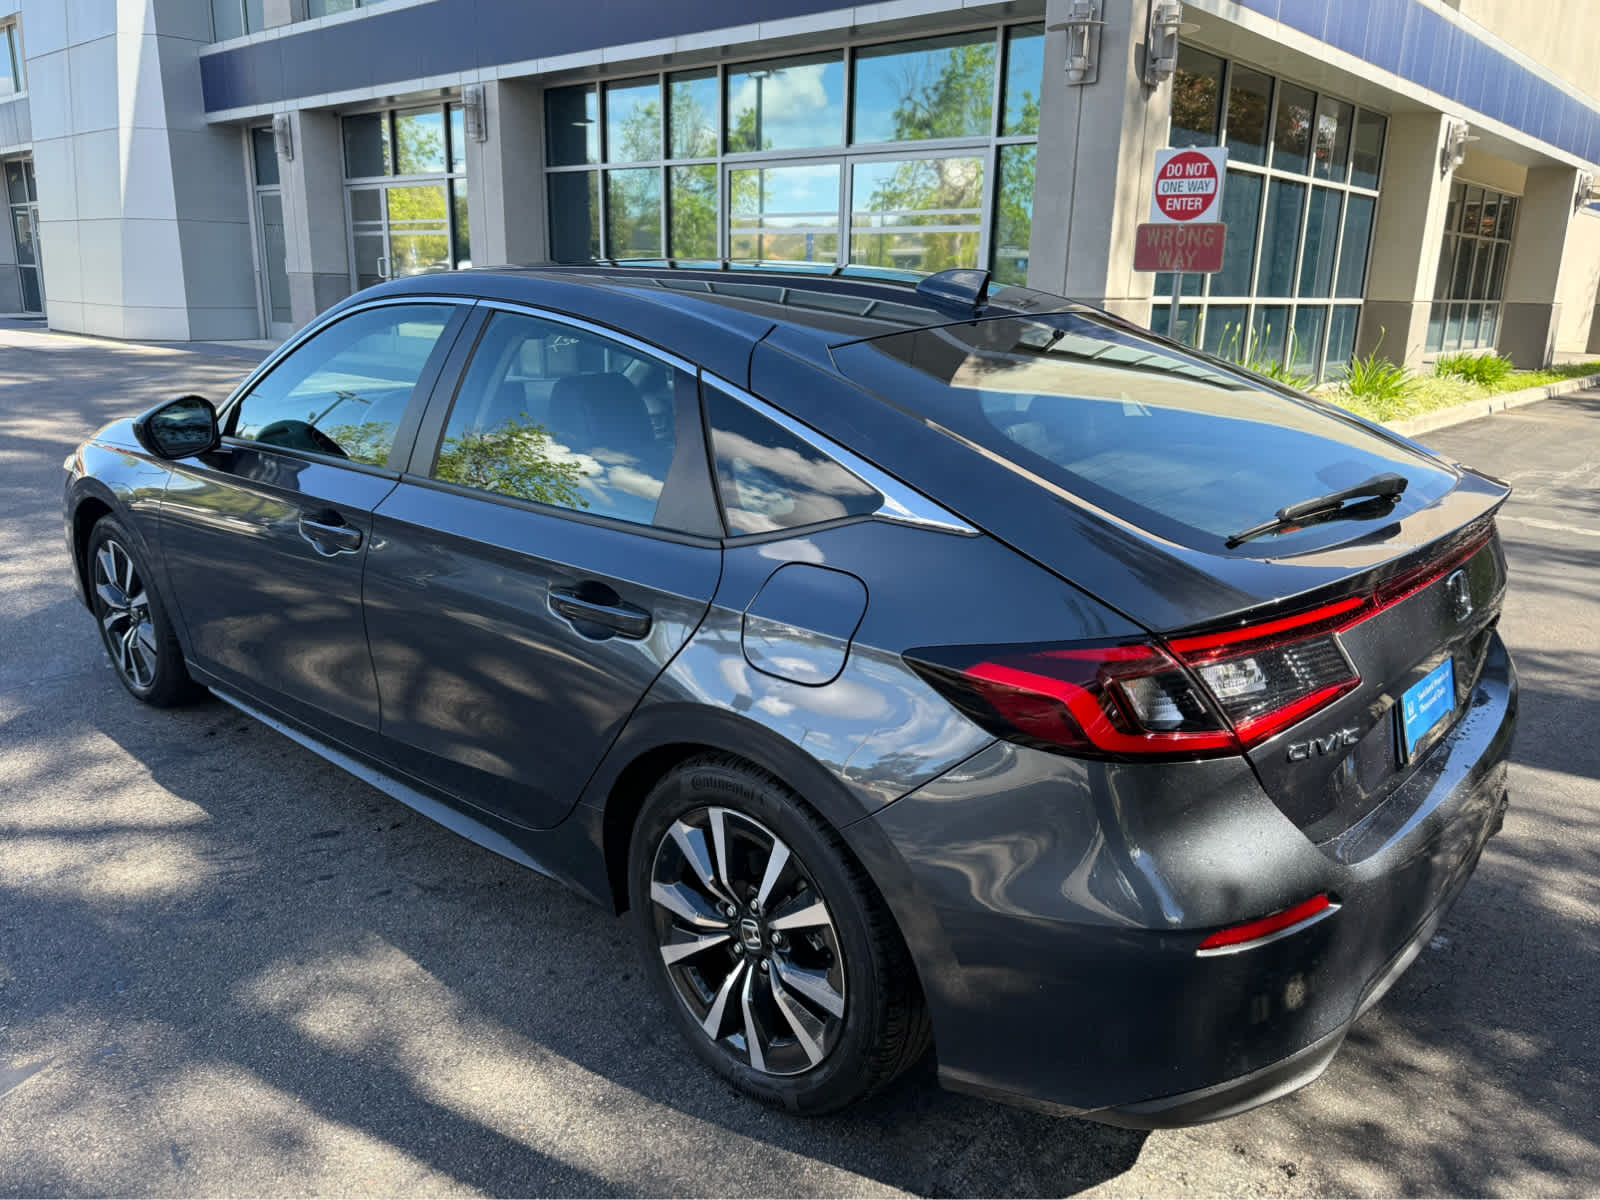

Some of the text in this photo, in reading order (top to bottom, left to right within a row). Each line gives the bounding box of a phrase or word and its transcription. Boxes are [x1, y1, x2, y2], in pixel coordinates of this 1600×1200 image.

[1166, 162, 1210, 177] DO NOT
[1161, 180, 1212, 193] ONE WAY
[1165, 197, 1203, 211] ENTER
[1146, 227, 1217, 248] WRONG
[1159, 249, 1198, 269] WAY
[1286, 727, 1360, 761] CIVIC
